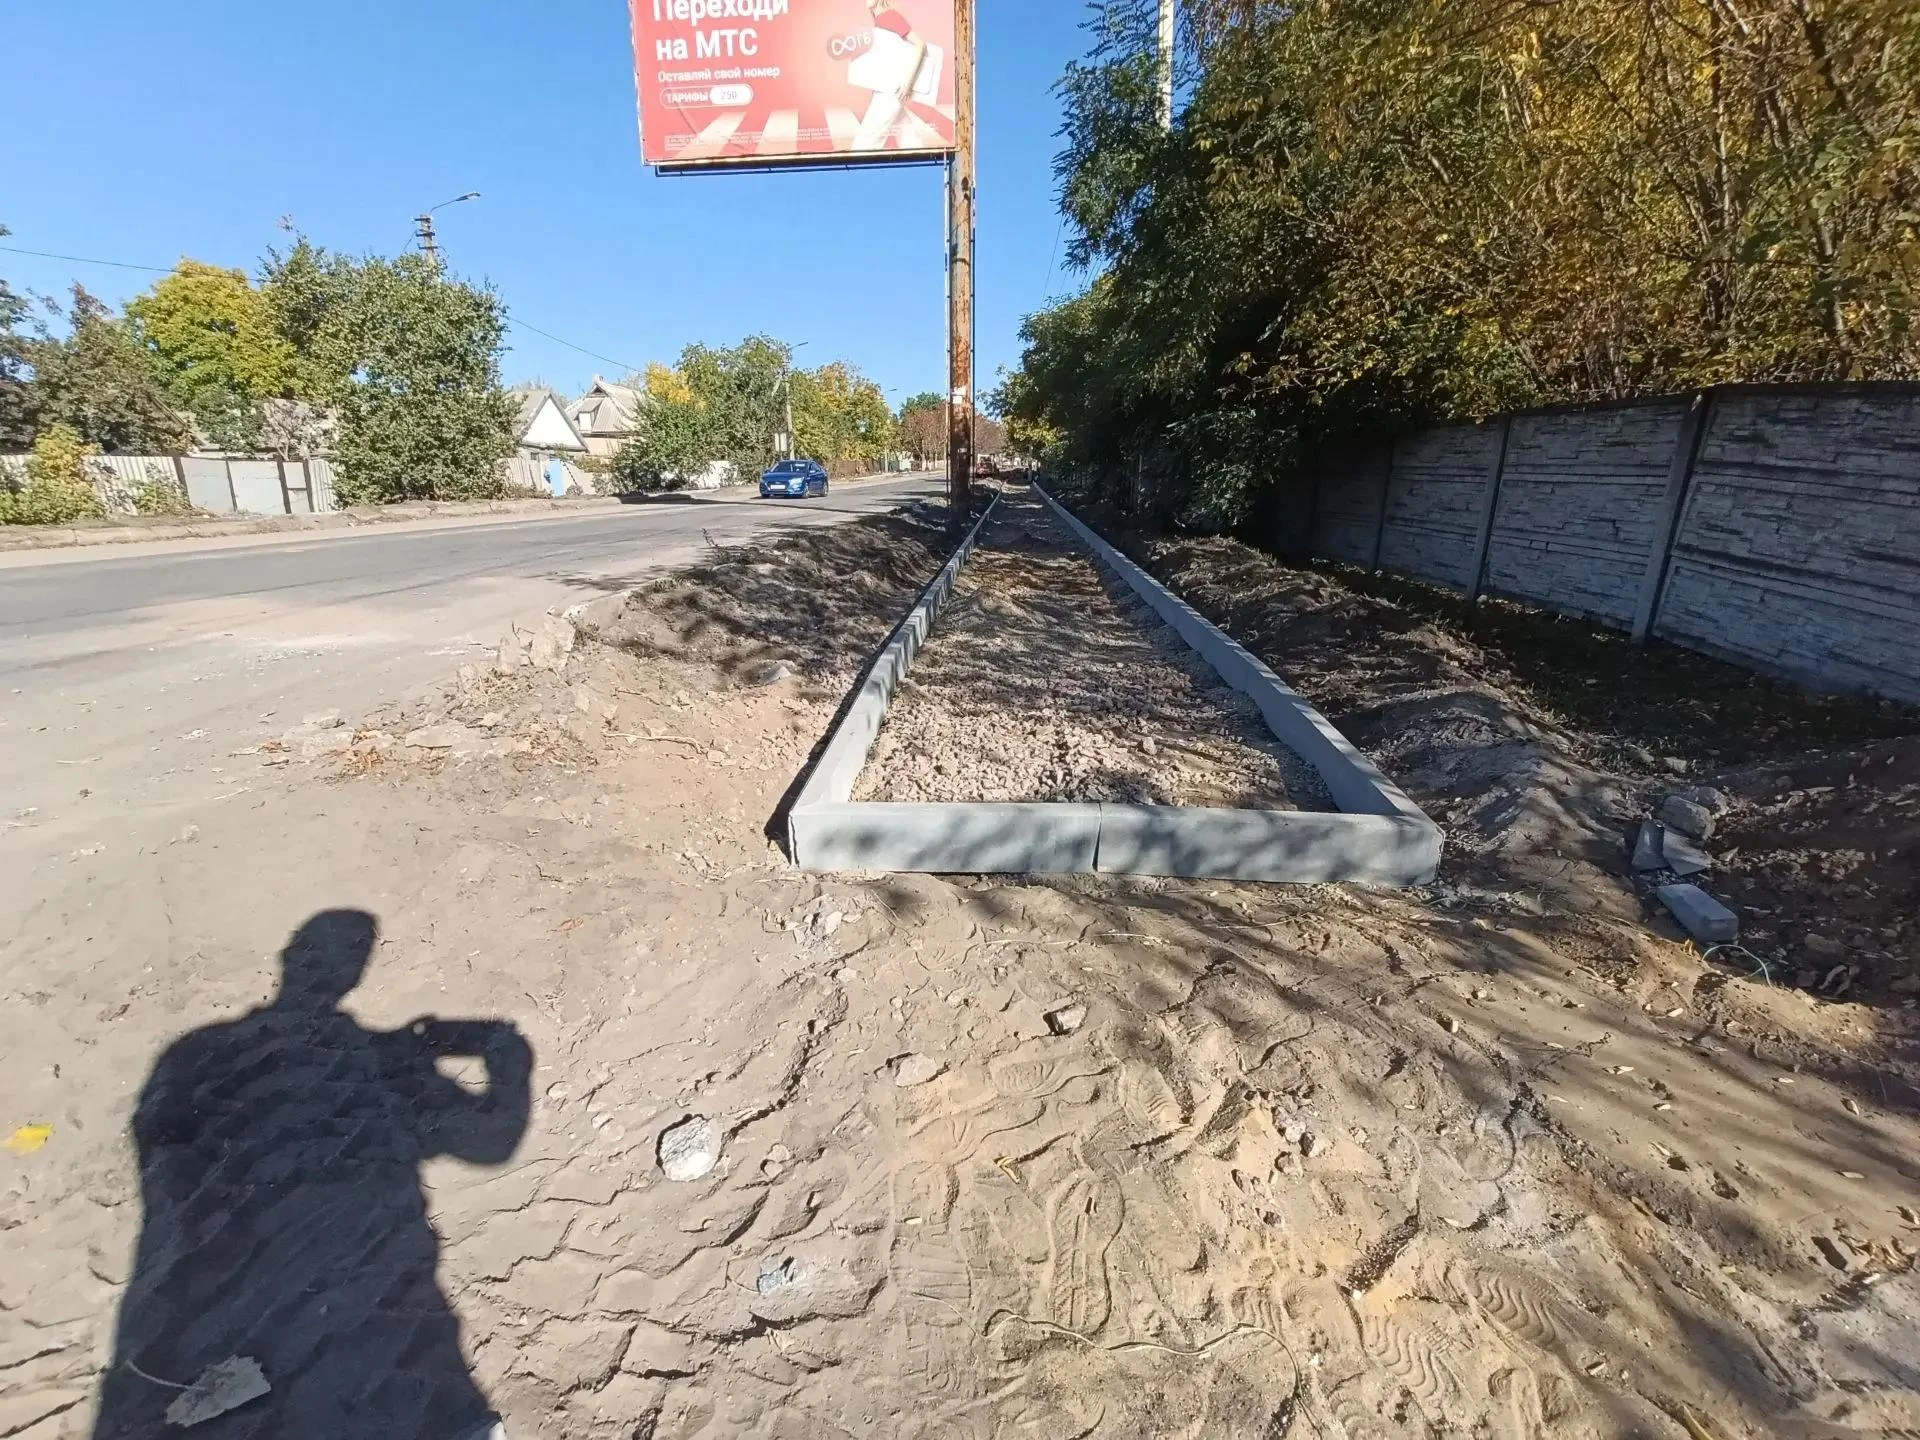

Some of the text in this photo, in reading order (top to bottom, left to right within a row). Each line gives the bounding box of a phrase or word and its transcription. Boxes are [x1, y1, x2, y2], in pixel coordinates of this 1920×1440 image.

[653, 0, 789, 27] Переходи
[655, 27, 758, 61] на МТС
[657, 66, 781, 83] Оставляй свой номер
[665, 92, 708, 104] ТАРИФЫ
